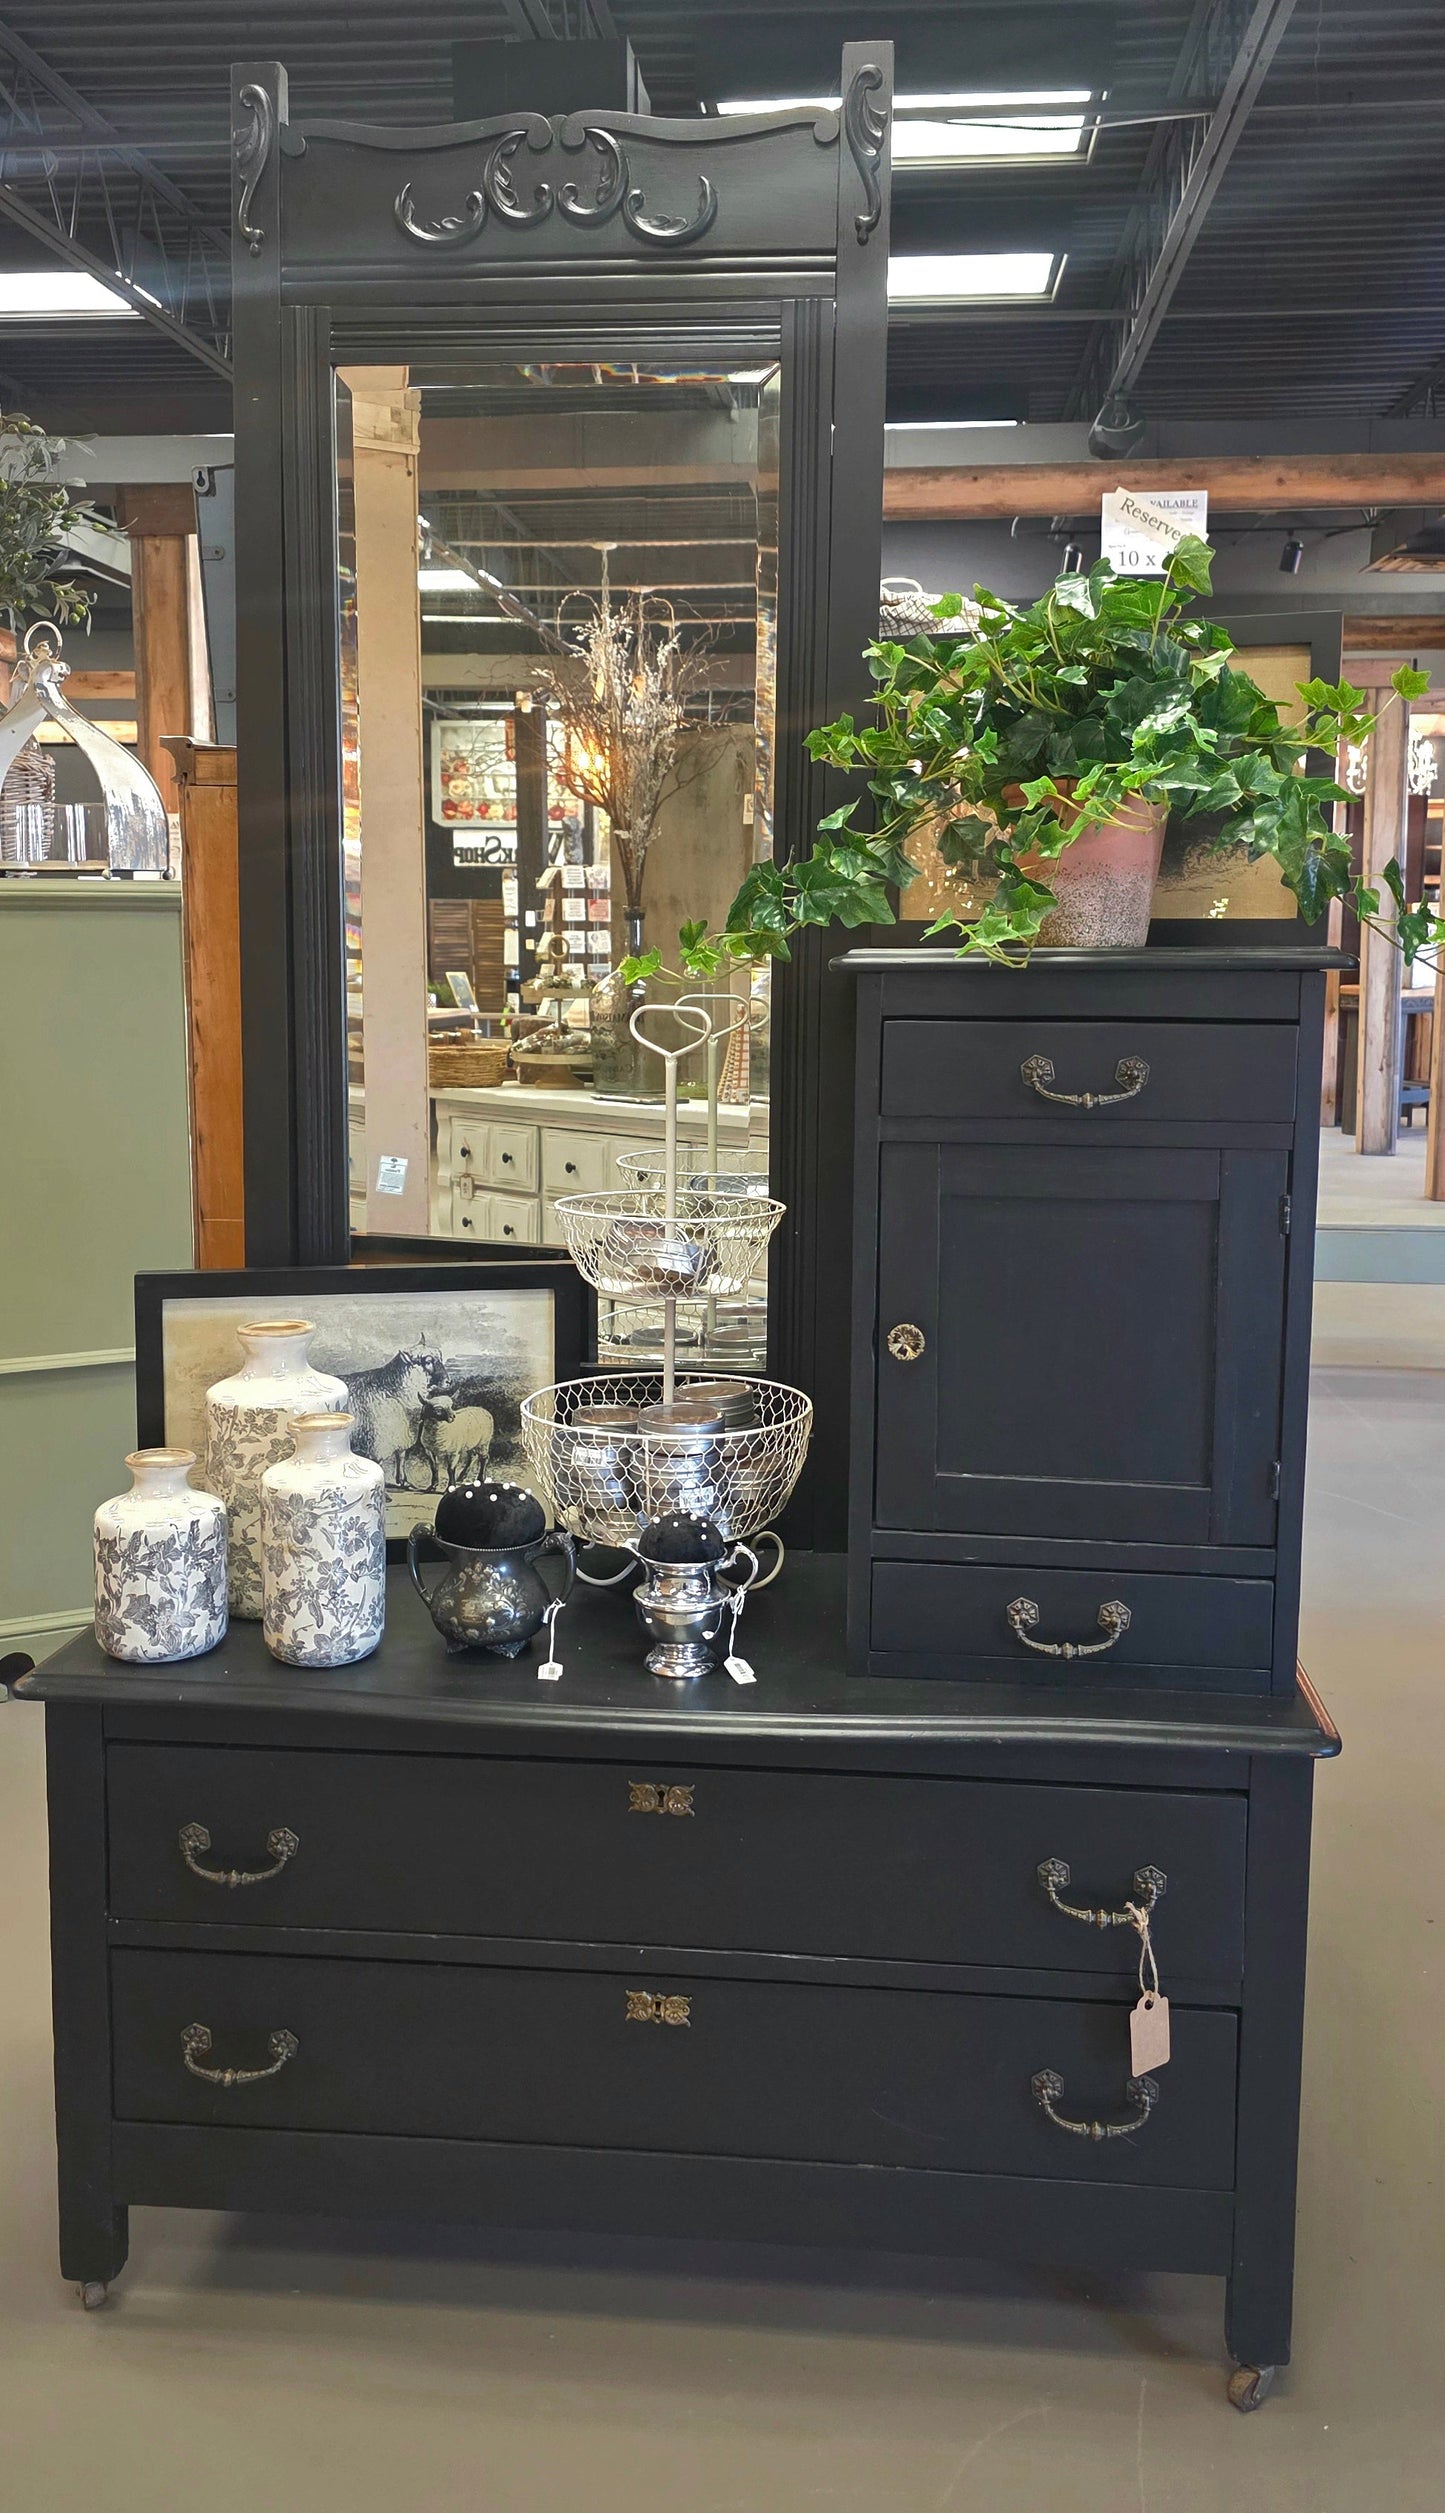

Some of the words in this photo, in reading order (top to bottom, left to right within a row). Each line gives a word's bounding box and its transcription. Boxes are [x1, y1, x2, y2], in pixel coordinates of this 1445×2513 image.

[1150, 499, 1198, 508] VAILABLE
[1119, 551, 1139, 566] 10
[1146, 555, 1156, 566] x
